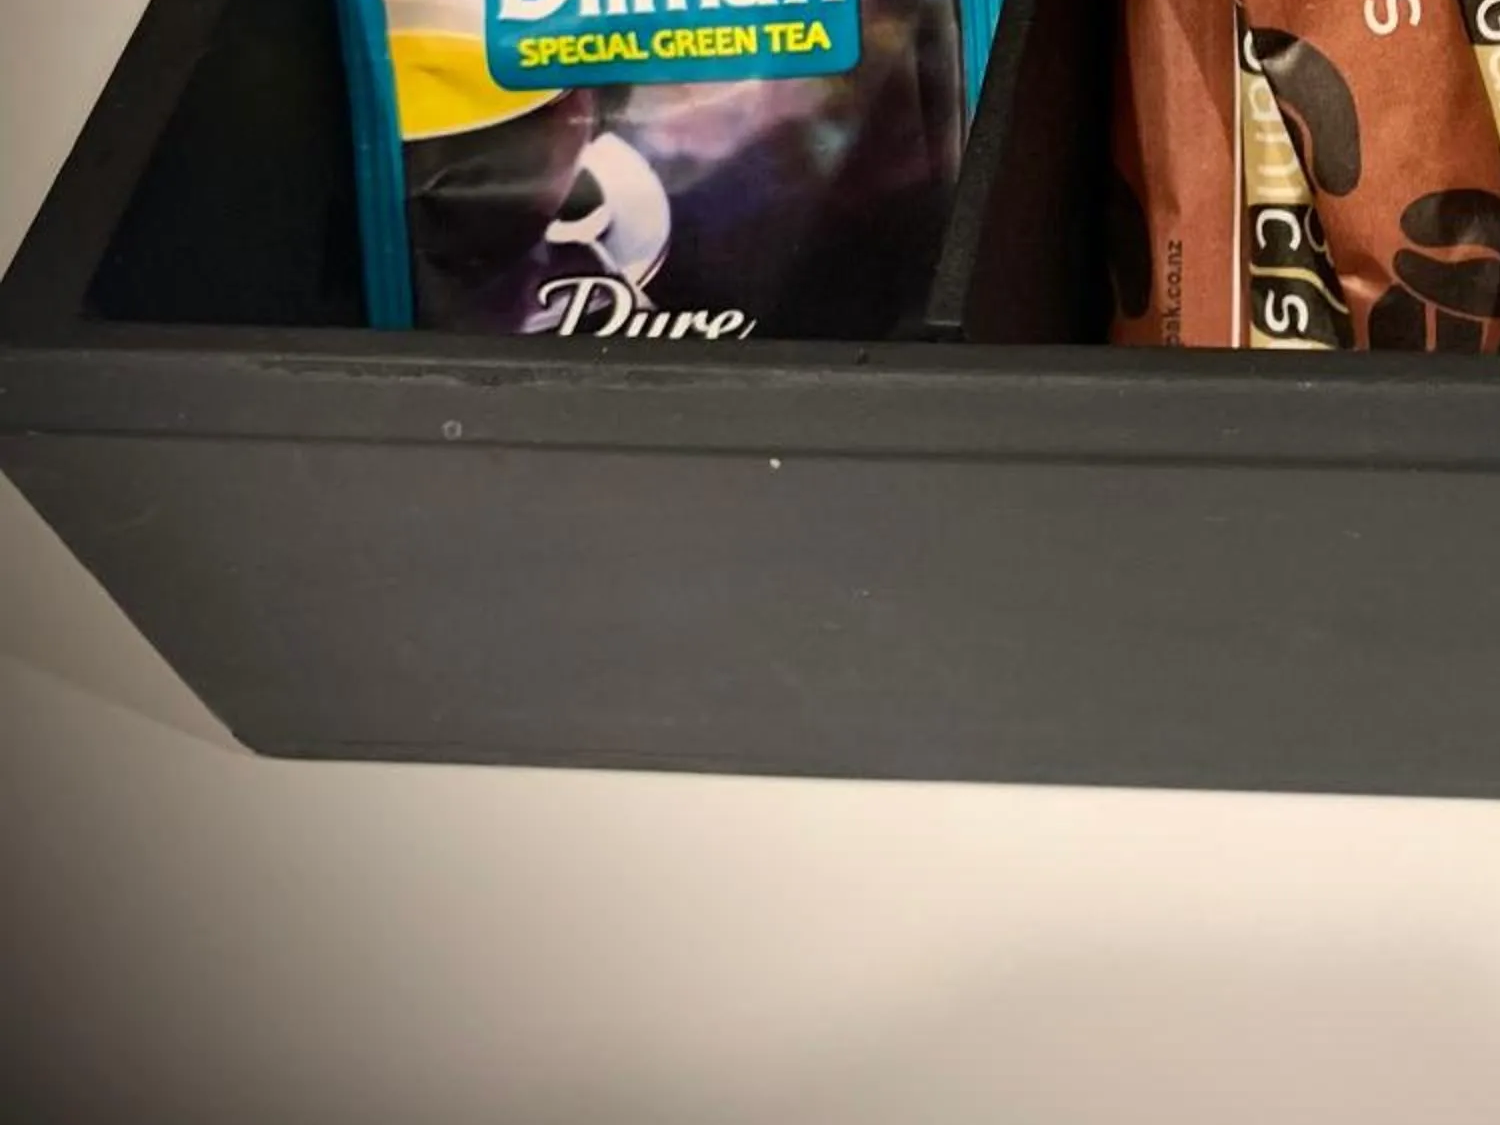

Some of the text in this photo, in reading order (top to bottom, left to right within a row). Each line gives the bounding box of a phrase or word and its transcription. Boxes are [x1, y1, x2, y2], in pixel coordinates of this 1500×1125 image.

[517, 21, 831, 68] SPECIAL GREEN TEA
